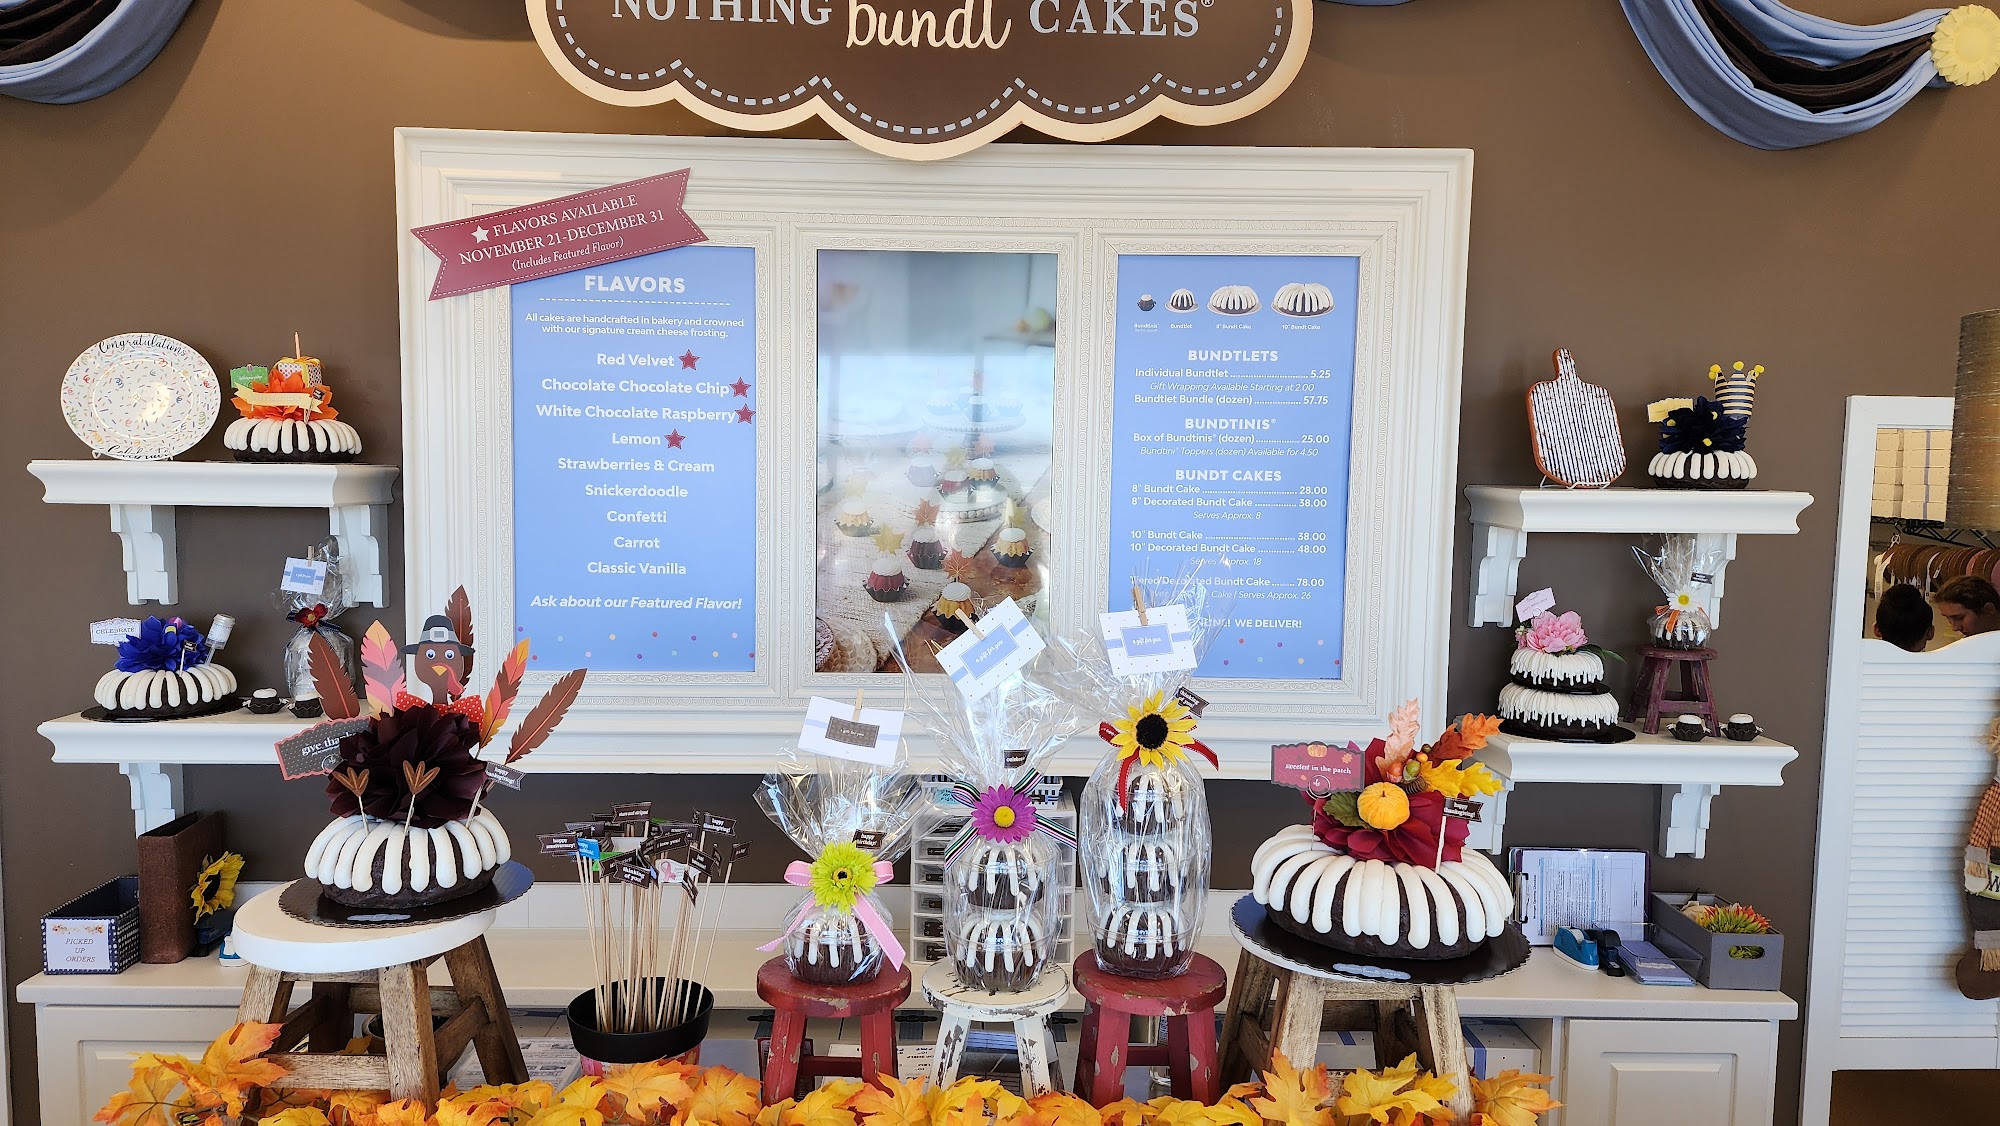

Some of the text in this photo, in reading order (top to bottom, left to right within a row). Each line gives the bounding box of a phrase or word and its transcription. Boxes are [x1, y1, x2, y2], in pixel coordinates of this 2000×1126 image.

[612, 0, 832, 25] NOTHING
[492, 194, 638, 237] FLAVORS AVAILABLE
[458, 208, 665, 265] NOVEMBER 21-DECEMBER 31
[511, 236, 624, 272] (Includes Featured Flavor)
[585, 275, 685, 293] FLAVORS
[525, 313, 744, 328] All cakes are handcrafted in bakery and crowned
[541, 325, 563, 334] with
[582, 325, 625, 337] signature
[626, 328, 655, 336] cream
[656, 327, 689, 336] cheese
[690, 328, 729, 339] frosting.
[99, 334, 187, 356] Congratulations
[597, 353, 674, 366] Red Velvet
[1188, 350, 1278, 361] BUNDTLETS
[1135, 368, 1331, 378] Individual Bundtlet 5.25
[541, 378, 730, 397] Chocolate Chocolate Chip
[1150, 382, 1166, 391] Gift
[1168, 382, 1209, 393] Wrapping
[1210, 382, 1249, 392] Available
[1250, 383, 1283, 393] Starting
[1134, 394, 1329, 405] Bundtlet Bundle (dozen) 57.75
[536, 405, 736, 423] White Chocolate Raspberry
[612, 433, 661, 445] Lemon
[1133, 433, 1151, 442] Box
[1154, 433, 1165, 442] of
[1218, 434, 1255, 444] (dozen)
[1301, 435, 1330, 443] 25.00
[1181, 447, 1213, 457] Toppers
[1215, 447, 1247, 457] (dozen)
[1248, 447, 1285, 456] Available
[1286, 448, 1299, 457] for
[557, 458, 715, 472] Strawberries & Cream
[1175, 470, 1282, 482] BUNDT CAKES
[585, 484, 688, 497] Snickerdoodle
[1131, 484, 1328, 495] 8" Bundt Cake 28.00
[1131, 497, 1328, 507] 8" Decorated Bundt Cake 38.00
[606, 511, 667, 523] Confetti
[1193, 511, 1220, 520] Serves
[1221, 511, 1254, 520] Approx.
[1130, 530, 1326, 541] 10" Bundt Cake 38.00
[613, 537, 660, 548] Carrot
[1130, 543, 1326, 554] 10" Decorated Bundt Cake 48.00
[1190, 557, 1217, 565] Serves
[1252, 558, 1262, 566] 18
[587, 562, 687, 574] Classic Vanilla
[1213, 577, 1244, 586] Bundt
[1245, 577, 1271, 586] Cake
[1296, 578, 1325, 587] 78.00
[530, 595, 742, 609] Ask about our Featured Flavor!
[1238, 591, 1265, 599] Serves
[1266, 591, 1299, 601] Approx.
[1300, 592, 1312, 600] 26
[1234, 619, 1253, 627] WE
[1254, 619, 1302, 628] DELIVER!
[301, 743, 323, 757] give
[1285, 763, 1310, 771] sweetest
[1320, 765, 1331, 773] the
[65, 955, 96, 963] ORDERS
